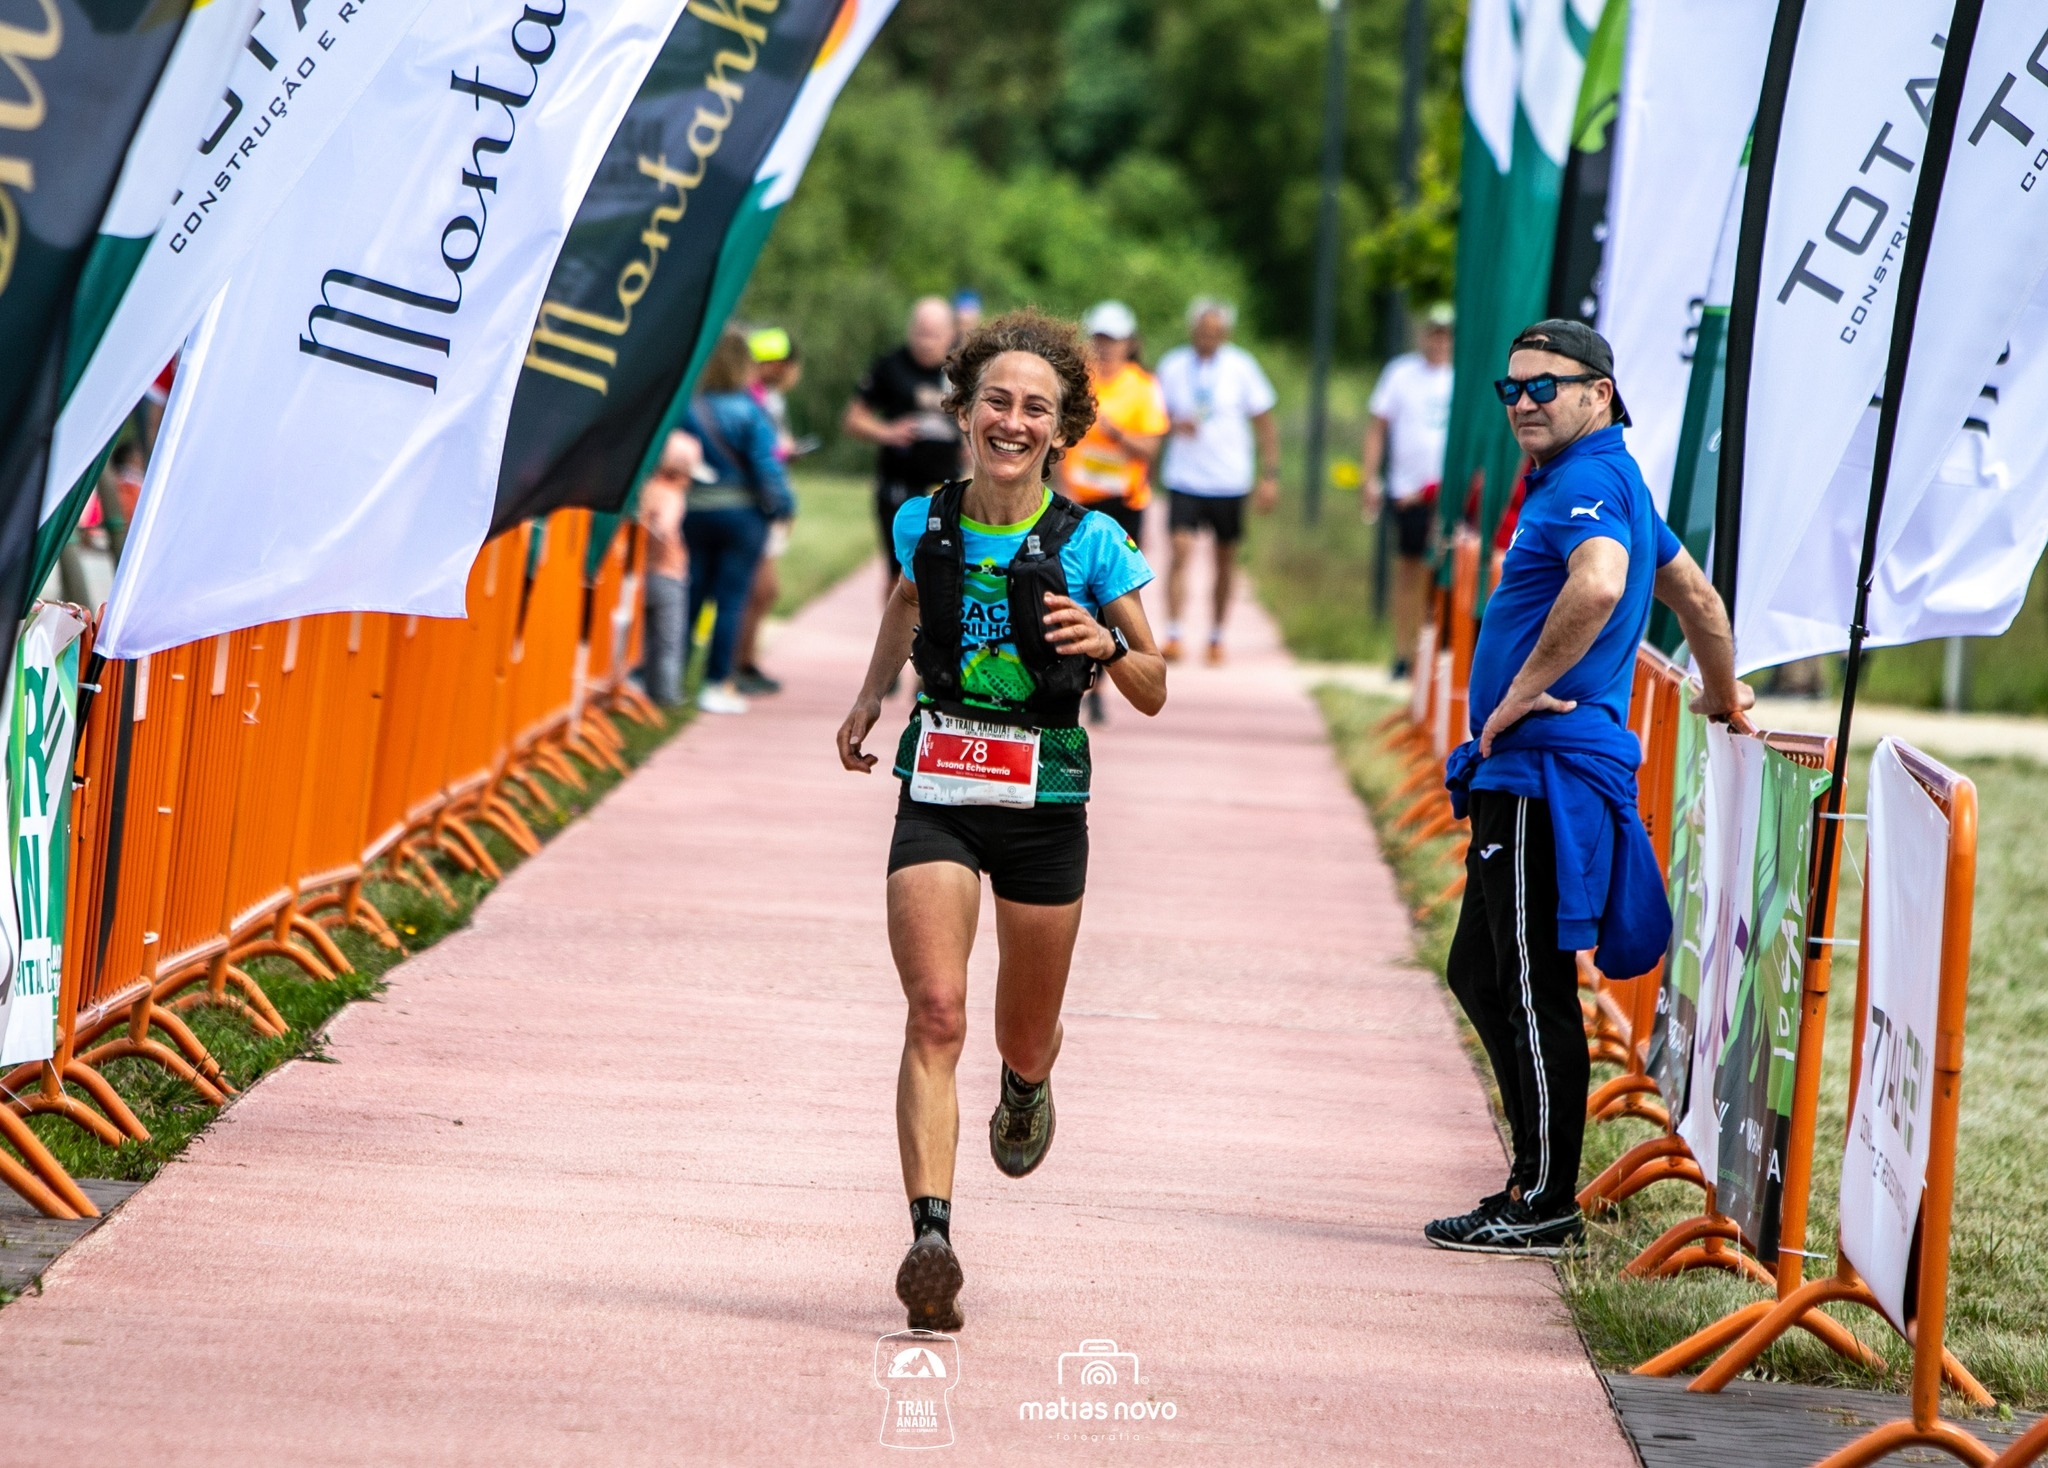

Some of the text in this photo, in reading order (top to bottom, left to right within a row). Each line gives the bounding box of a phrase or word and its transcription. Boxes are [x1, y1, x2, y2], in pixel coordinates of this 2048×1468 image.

[169, 57, 316, 254] CONSTRUÇÃO
[317, 30, 336, 51] E
[1777, 32, 1947, 306] TOTA
[955, 719, 975, 732] TRAIL
[959, 738, 988, 763] 78
[936, 759, 964, 770] Susana
